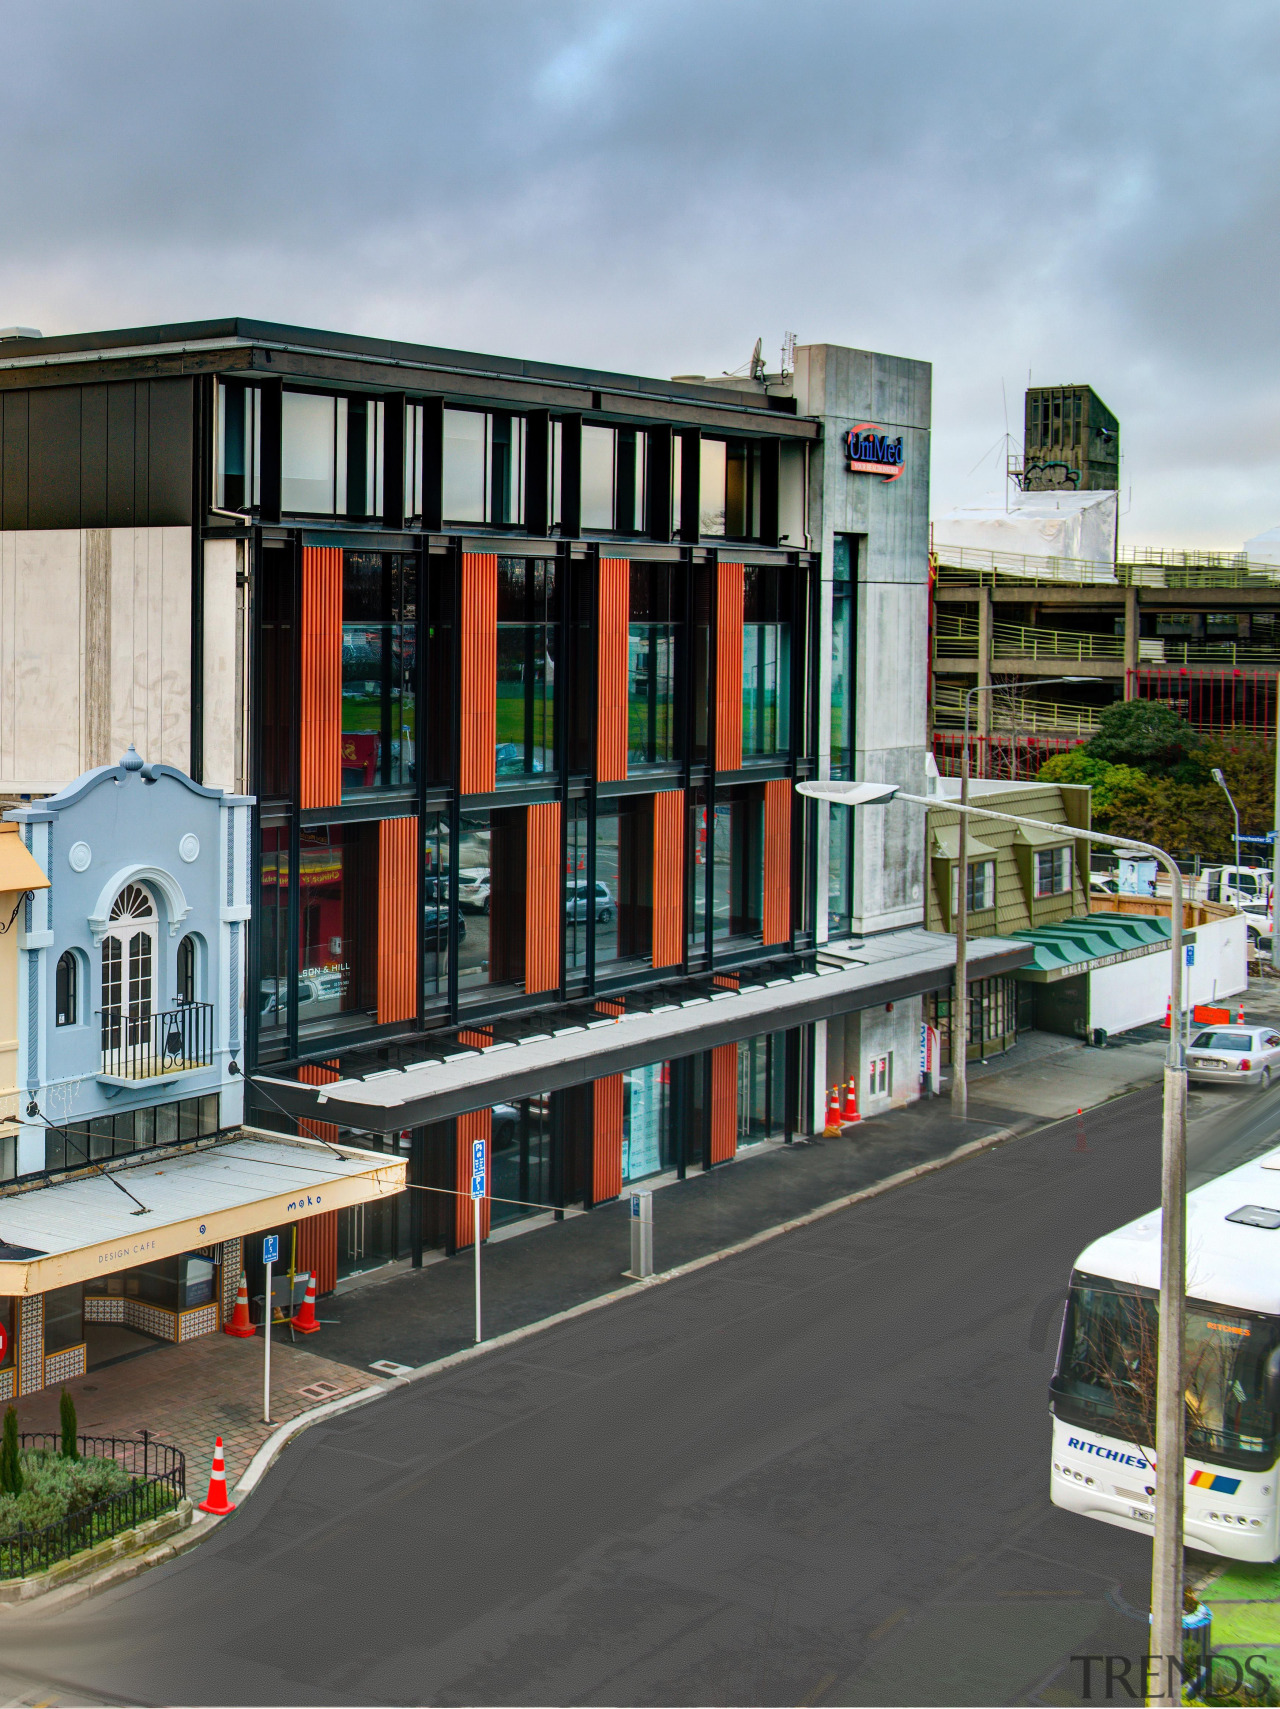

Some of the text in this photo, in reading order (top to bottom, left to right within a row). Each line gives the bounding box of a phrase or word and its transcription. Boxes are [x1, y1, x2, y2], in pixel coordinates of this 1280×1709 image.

[850, 432, 904, 464] UniMed
[299, 967, 320, 977] SON
[331, 963, 350, 972] HILL
[287, 1195, 322, 1212] moko
[98, 1240, 156, 1263] DESIGN CAFE
[269, 1239, 273, 1247] P
[1207, 1321, 1251, 1337] RITCHIES
[1068, 1437, 1148, 1469] RITCHIES
